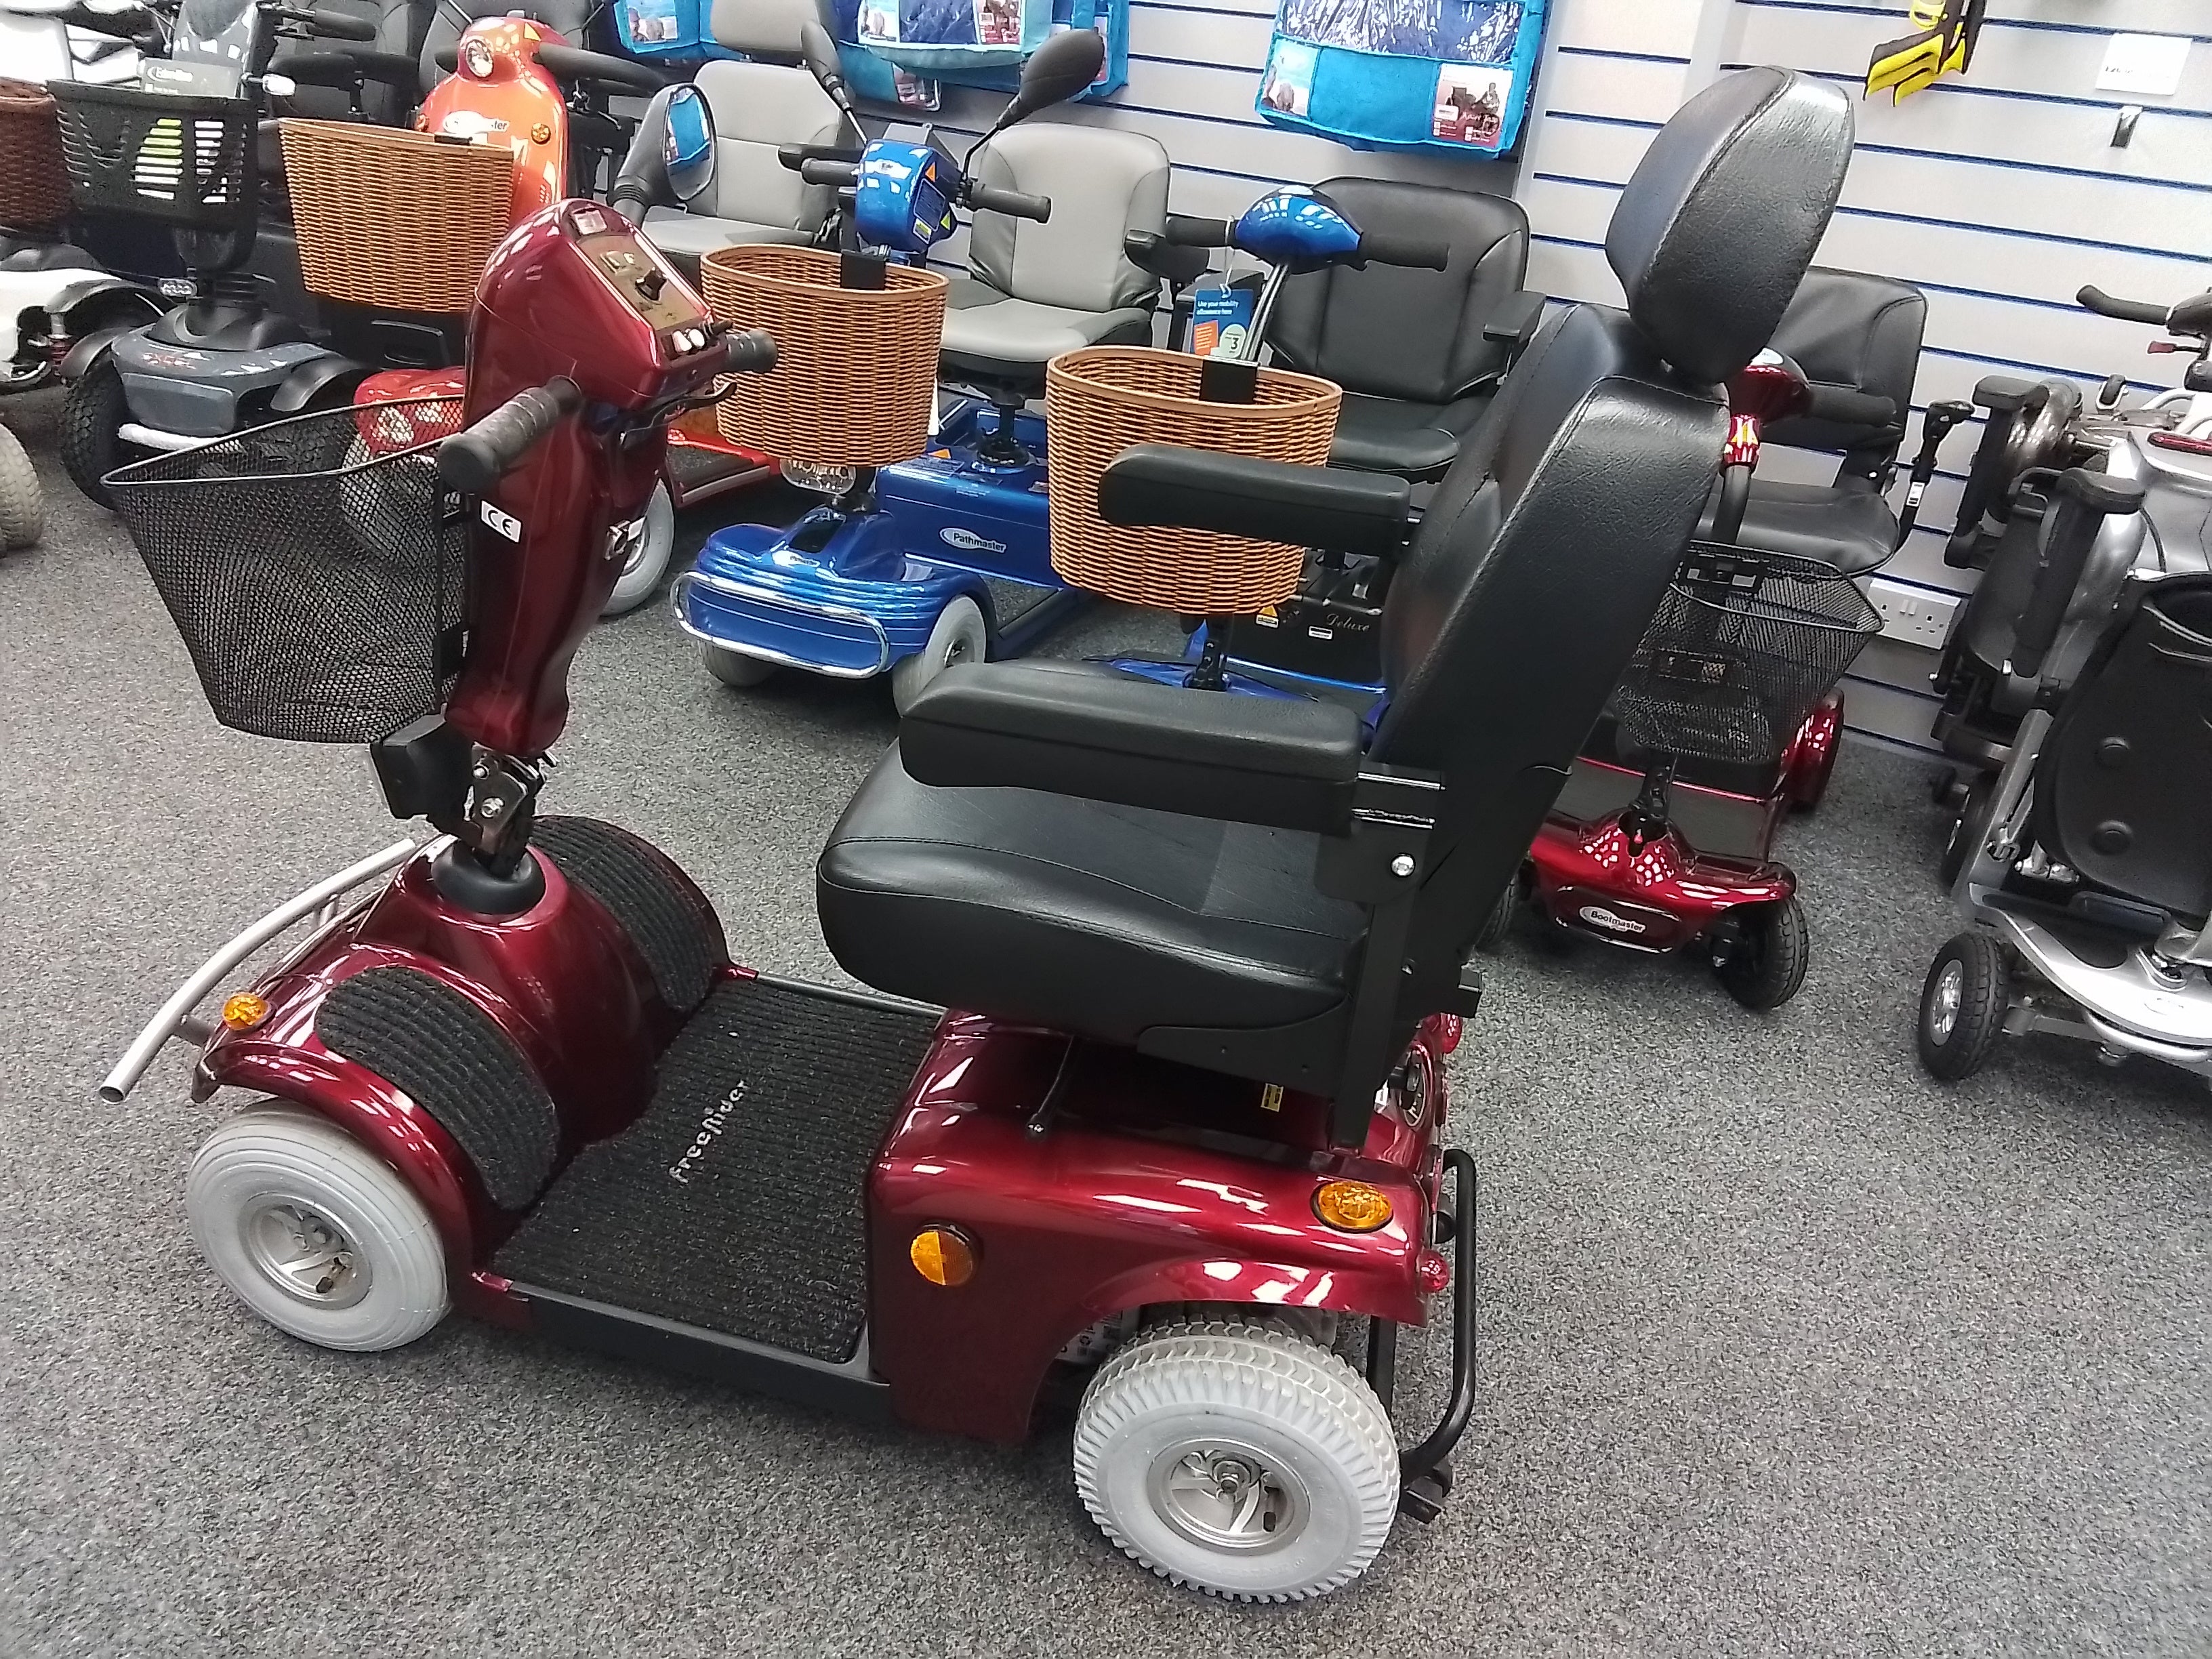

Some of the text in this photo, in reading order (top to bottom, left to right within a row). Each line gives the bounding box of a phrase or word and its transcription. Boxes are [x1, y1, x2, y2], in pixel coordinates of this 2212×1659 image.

[1230, 337, 1240, 350] 3
[487, 509, 514, 537] CE
[954, 532, 1005, 552] Pathmaster
[1326, 613, 1370, 632] Deluxe
[1591, 910, 1643, 931] Bootmaster
